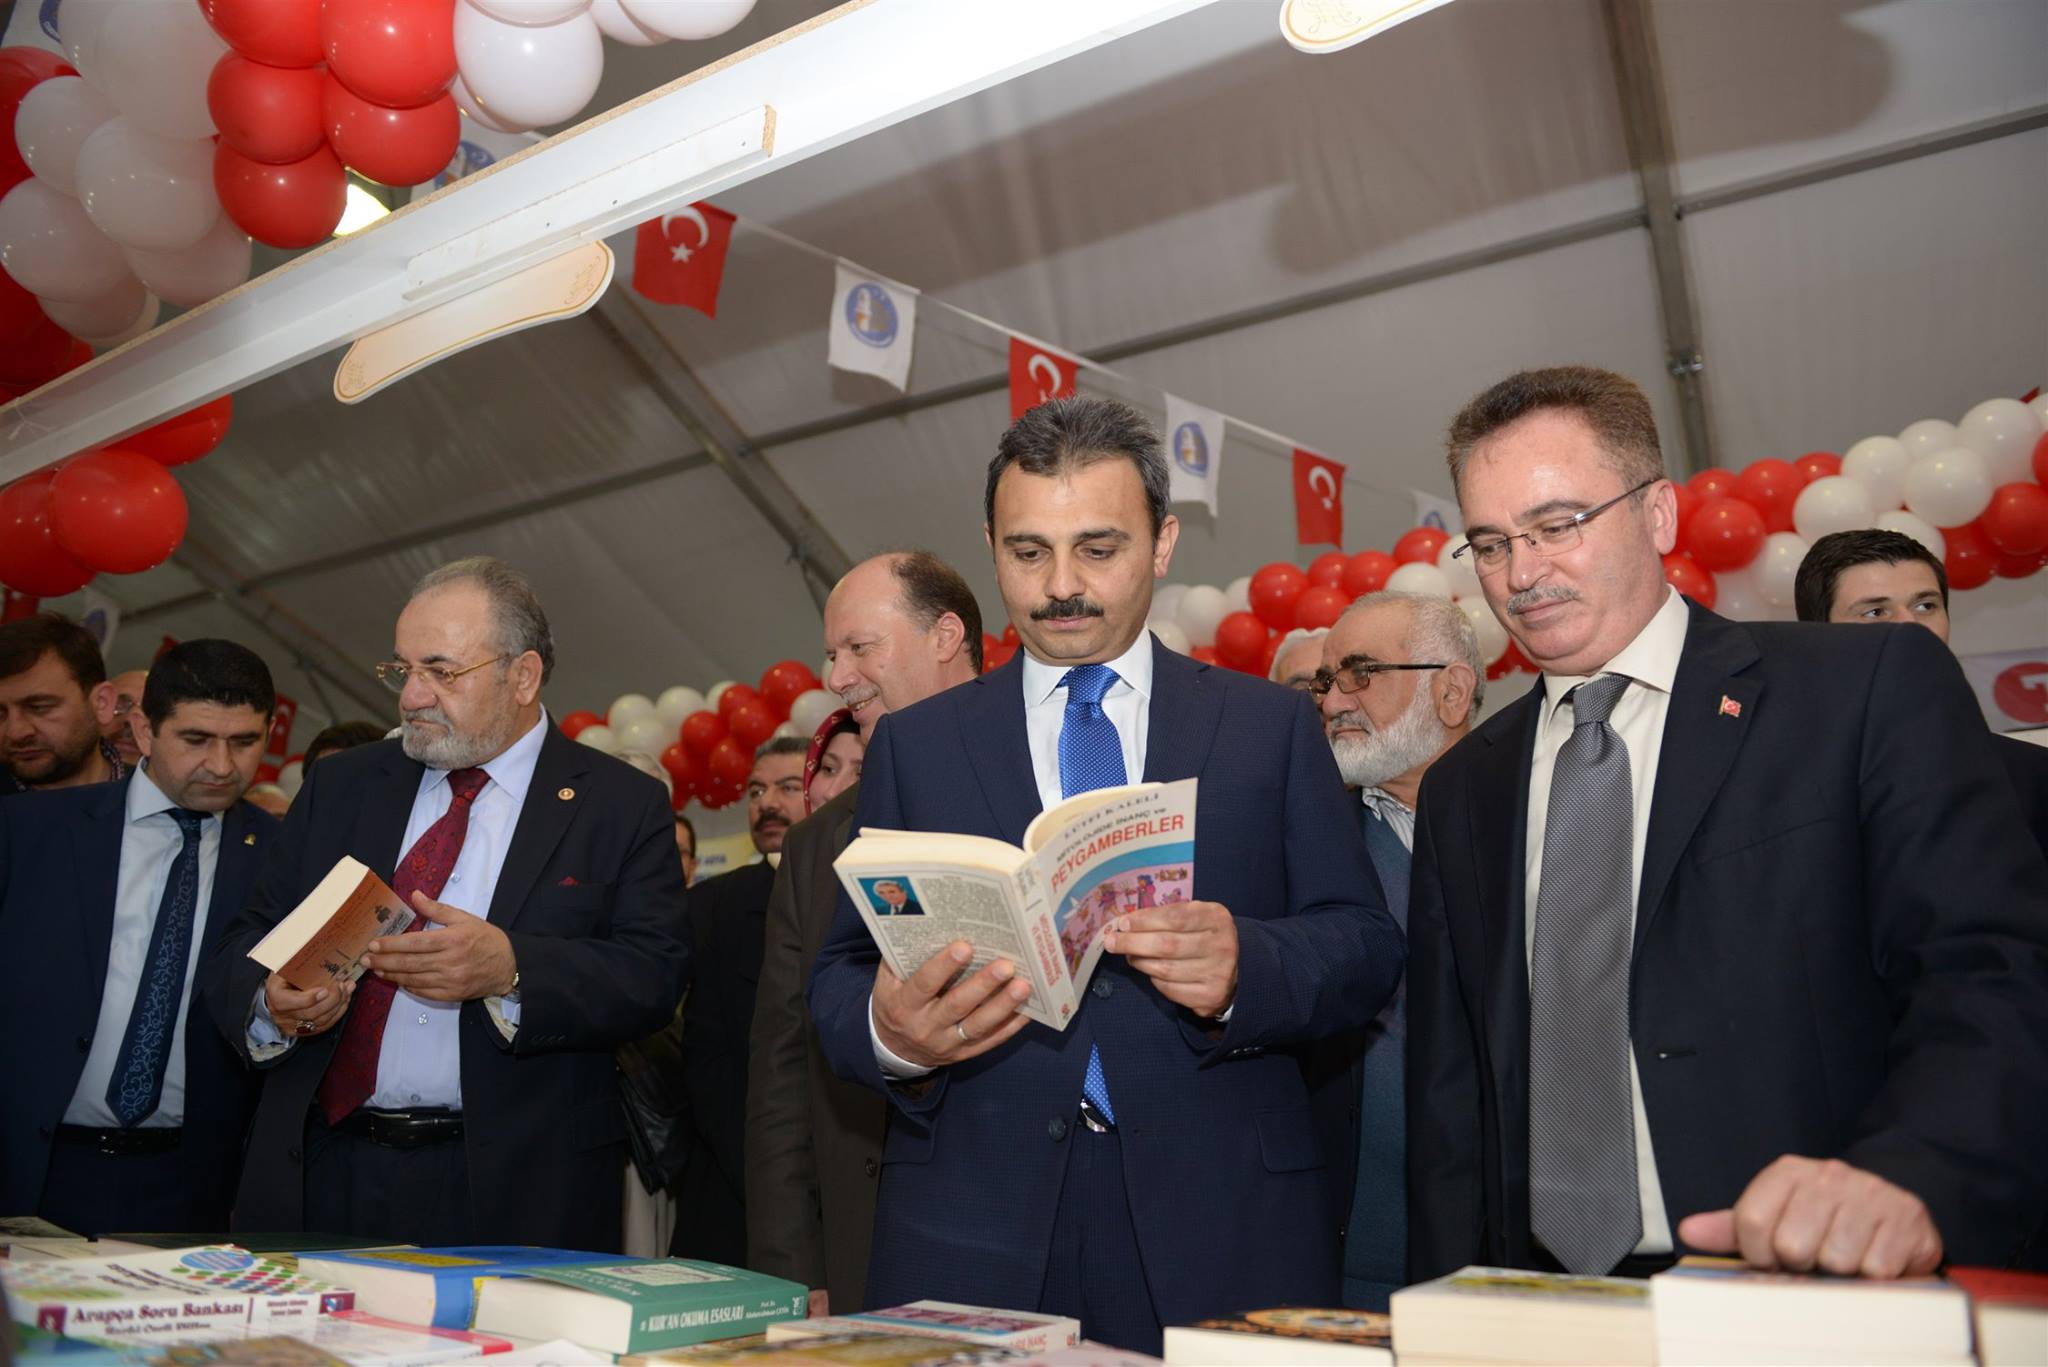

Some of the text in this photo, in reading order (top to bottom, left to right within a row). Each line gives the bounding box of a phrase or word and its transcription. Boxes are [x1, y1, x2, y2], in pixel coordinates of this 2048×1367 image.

[1051, 814, 1185, 894] PEYGAMBERLER
[73, 1301, 244, 1324] Arapça Soru Bankası
[680, 1309, 709, 1328] OKUMA
[710, 1305, 745, 1324] ESASLARI
